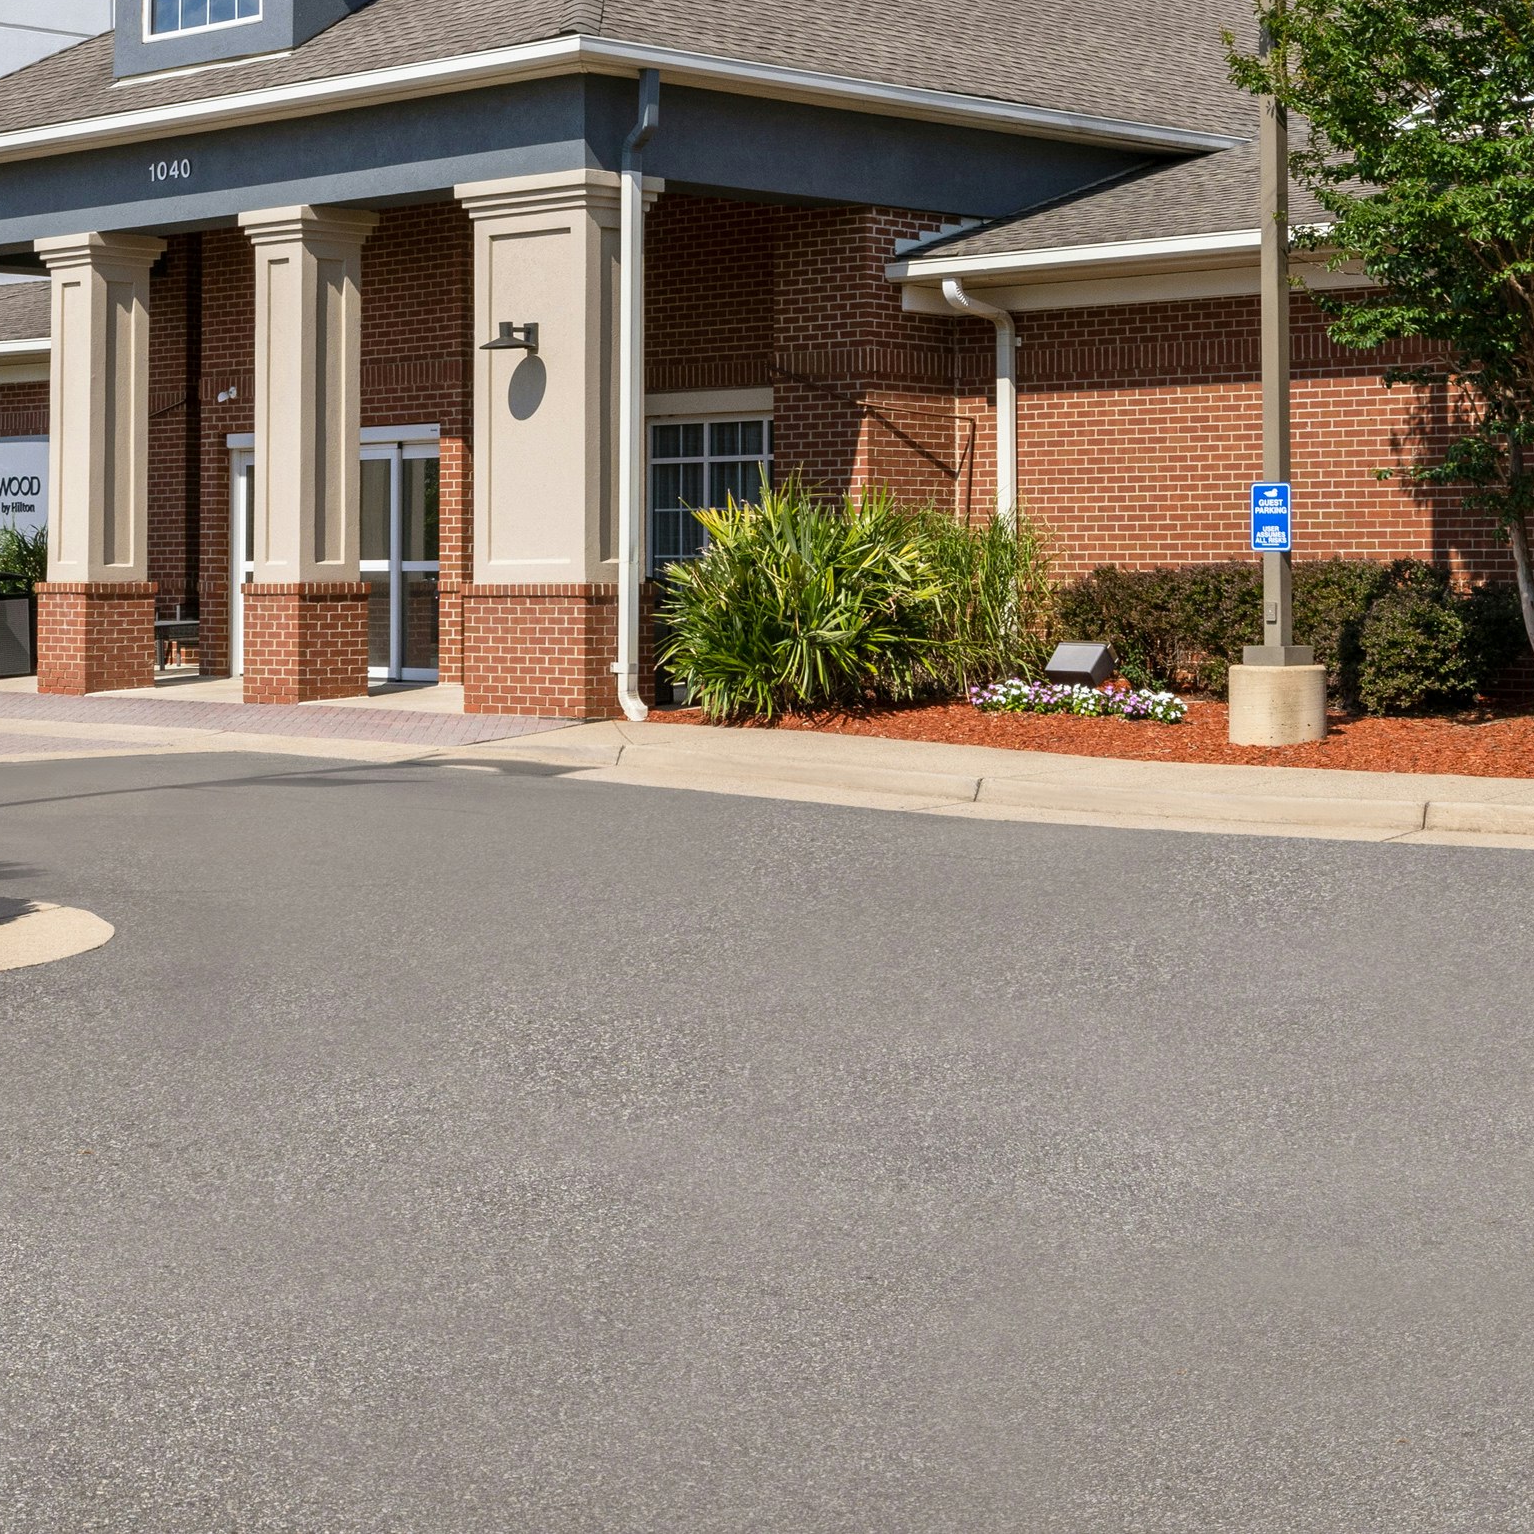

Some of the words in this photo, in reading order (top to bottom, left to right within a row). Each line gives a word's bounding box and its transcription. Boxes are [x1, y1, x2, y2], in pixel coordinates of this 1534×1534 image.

[149, 159, 190, 182] 1040
[1, 502, 11, 515] by
[11, 501, 36, 513] Hilton
